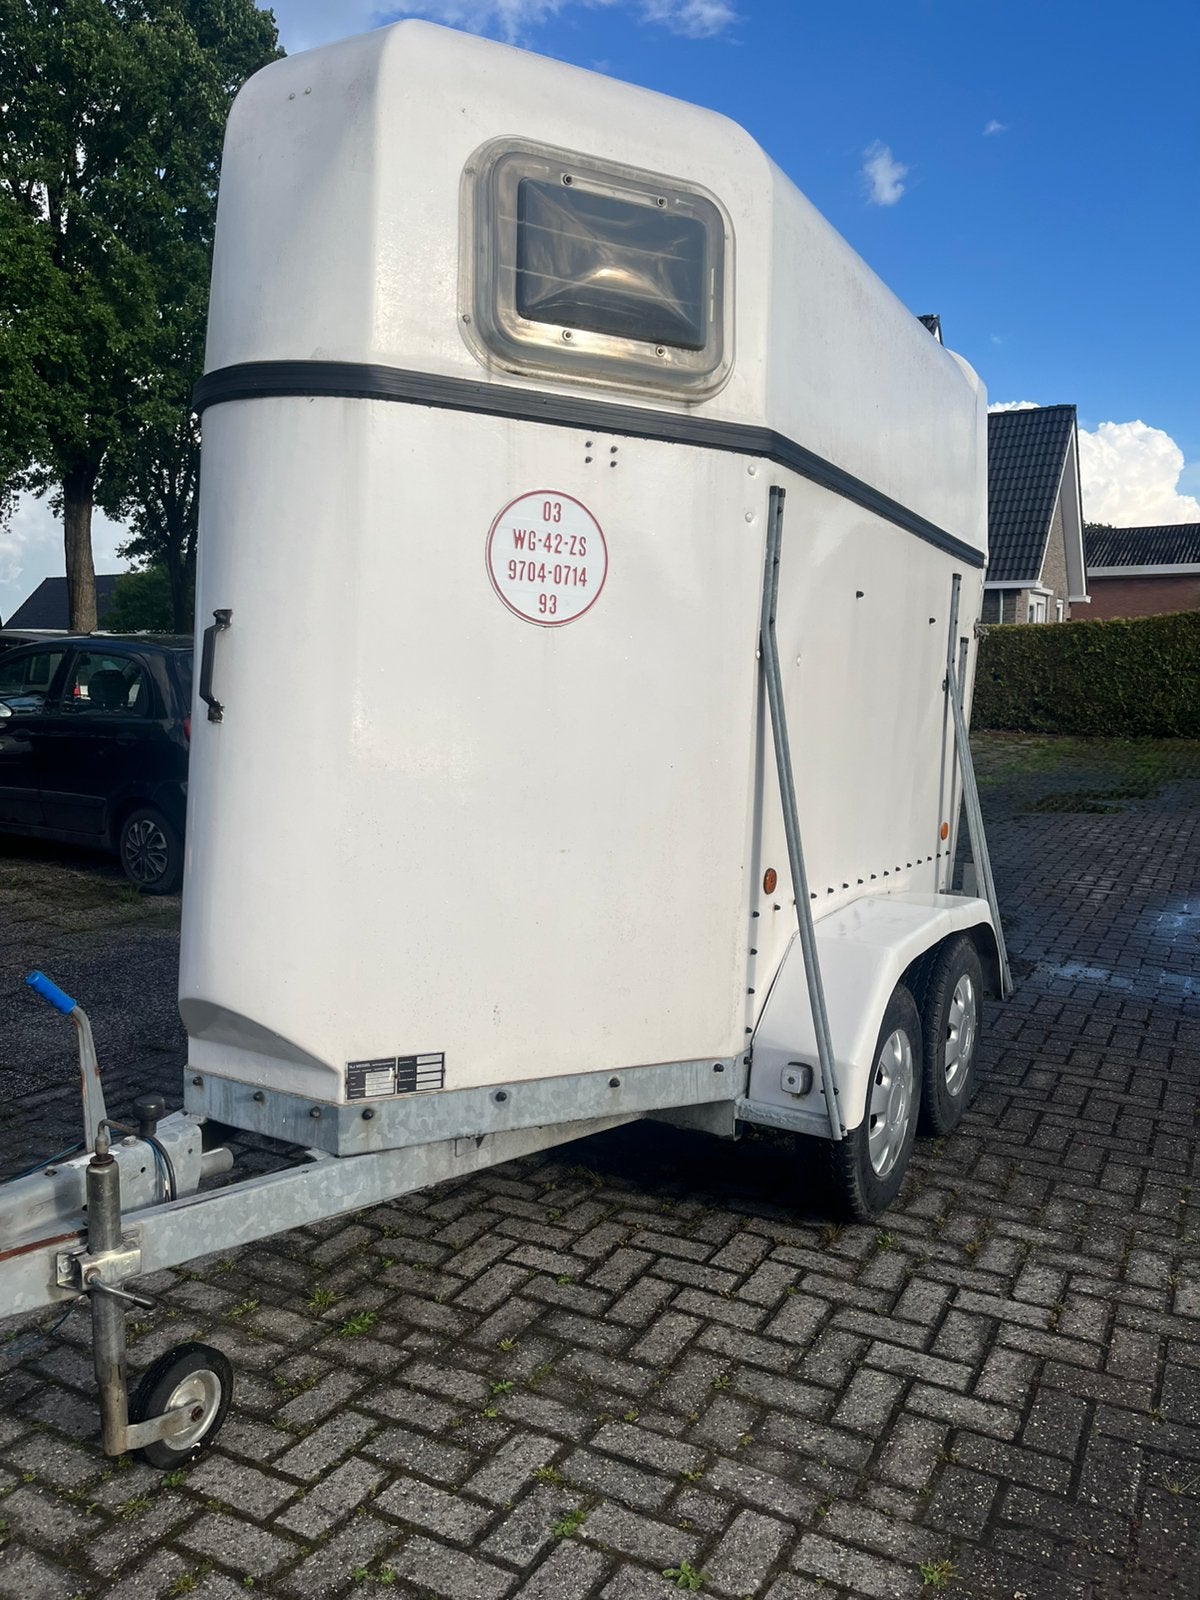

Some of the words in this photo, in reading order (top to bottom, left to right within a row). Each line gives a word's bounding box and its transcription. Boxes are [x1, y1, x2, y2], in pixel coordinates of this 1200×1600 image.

[543, 501, 562, 523] 03
[513, 529, 587, 557] WG-42-ZS
[508, 560, 587, 587] 9704-0714
[539, 593, 558, 615] 93
